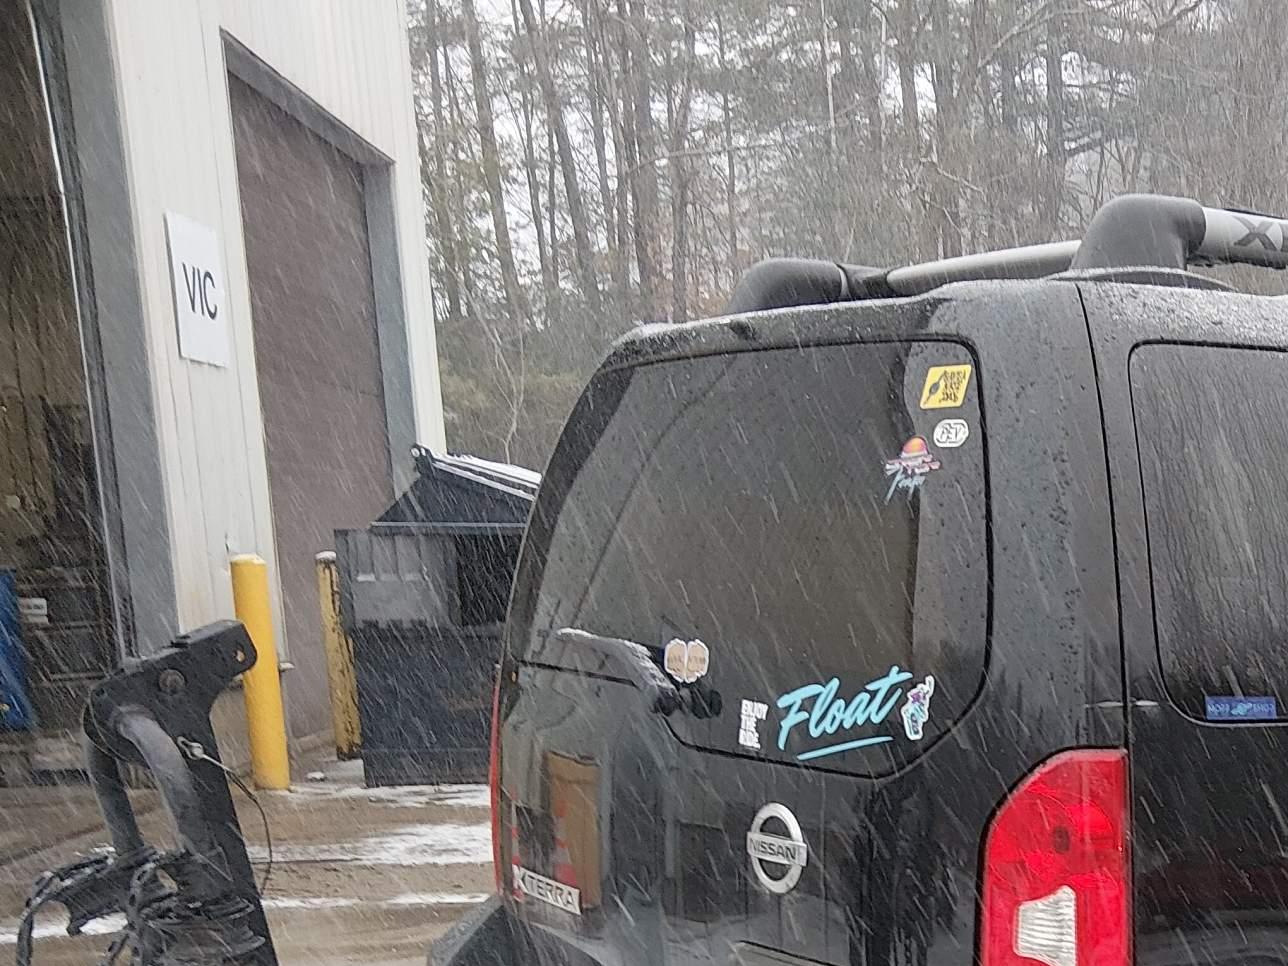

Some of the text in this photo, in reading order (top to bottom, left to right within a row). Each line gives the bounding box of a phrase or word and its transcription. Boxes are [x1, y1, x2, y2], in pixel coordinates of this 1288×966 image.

[182, 262, 217, 320] VIC
[776, 664, 914, 751] Float
[750, 838, 798, 861] NISSAN
[512, 863, 581, 915] XTERRA
